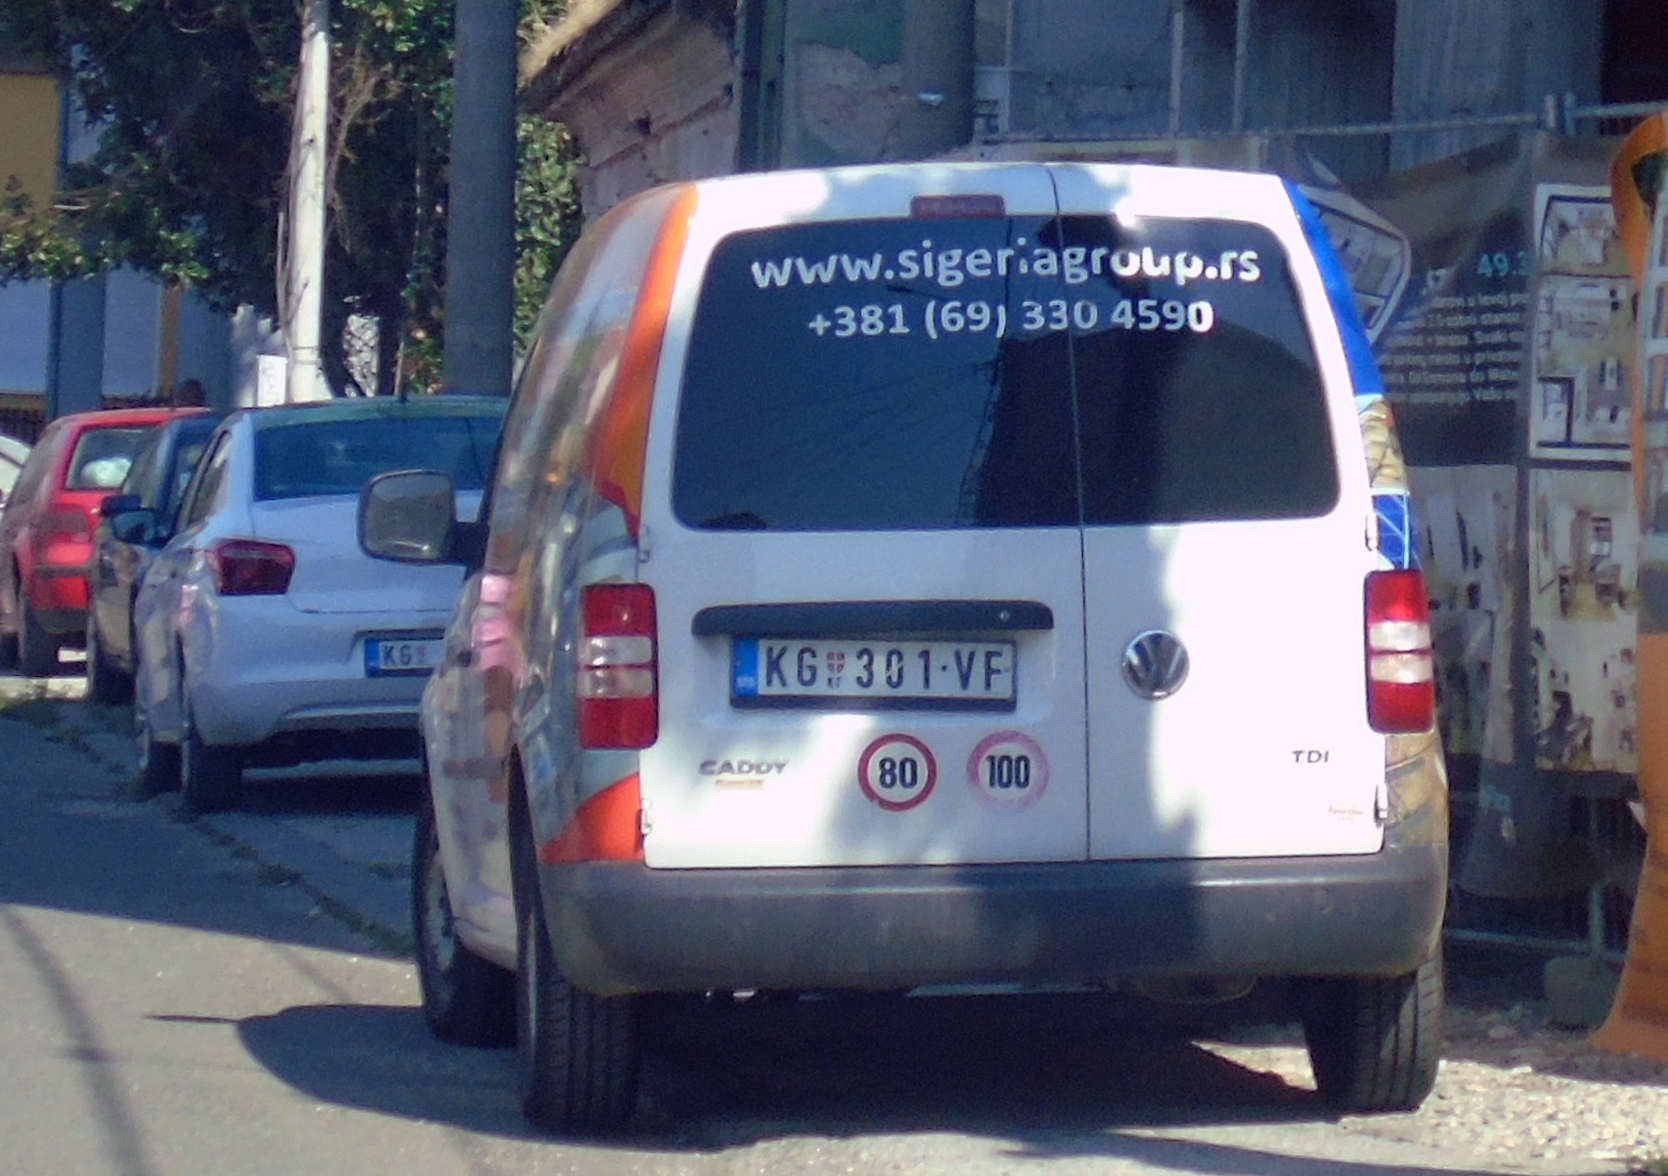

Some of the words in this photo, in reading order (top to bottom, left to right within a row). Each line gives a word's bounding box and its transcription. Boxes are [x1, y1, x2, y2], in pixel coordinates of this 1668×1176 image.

[751, 238, 1261, 289] www.sigeriagroup.rs
[808, 304, 910, 337] +381
[924, 300, 1006, 340] (69)
[1021, 300, 1097, 331] 330
[1110, 300, 1215, 333] 4590
[382, 645, 412, 666] KG
[765, 645, 818, 688] KG
[699, 759, 790, 776] CADDY
[878, 756, 918, 789] 80
[985, 755, 1031, 789] 100
[1292, 750, 1330, 763] TDI
